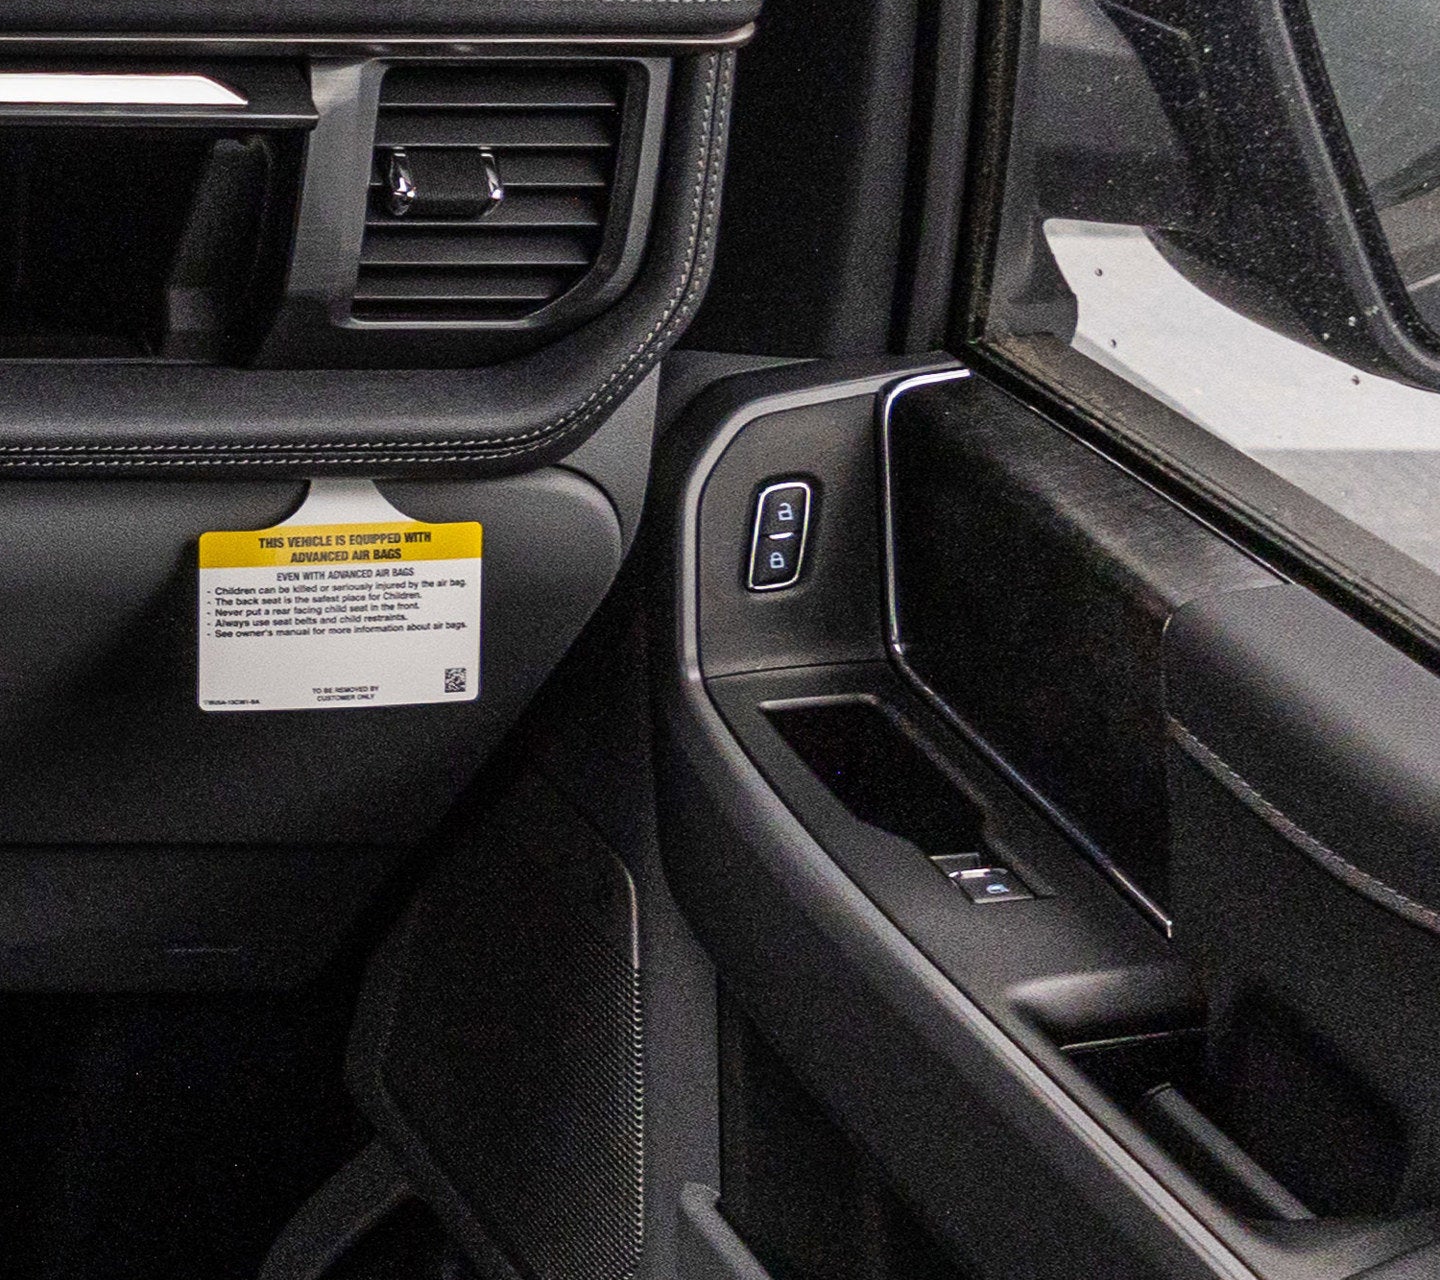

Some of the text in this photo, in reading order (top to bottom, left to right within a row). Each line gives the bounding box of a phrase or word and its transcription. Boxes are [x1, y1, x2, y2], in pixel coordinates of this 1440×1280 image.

[258, 531, 432, 549] THIS VEHICLE IS EQUIPPED WITH
[290, 548, 402, 563] ADVANCED AIR BAGS
[276, 567, 415, 582] EVEN WITH ADVANCED AIR BAGS
[214, 587, 256, 596] Children
[258, 587, 276, 595] can
[278, 586, 290, 594] be
[332, 583, 373, 592] seriously
[375, 581, 406, 591] injured
[408, 581, 419, 590] by
[421, 580, 435, 588] the
[214, 597, 233, 606] The
[236, 597, 259, 606] back
[261, 597, 282, 605] seat
[283, 596, 292, 604] is
[312, 595, 340, 603] safest
[342, 594, 366, 603] place
[368, 593, 381, 601] for
[383, 592, 422, 600] Children.
[214, 608, 243, 617] Never
[246, 608, 262, 617] put
[294, 606, 322, 616] facing
[325, 605, 347, 613] child
[381, 603, 395, 611] the
[214, 629, 233, 638] See
[235, 629, 273, 637] owner's
[276, 628, 311, 636] manual
[312, 627, 326, 635] for
[354, 624, 404, 633] information
[406, 623, 431, 631] about
[433, 622, 444, 630] air
